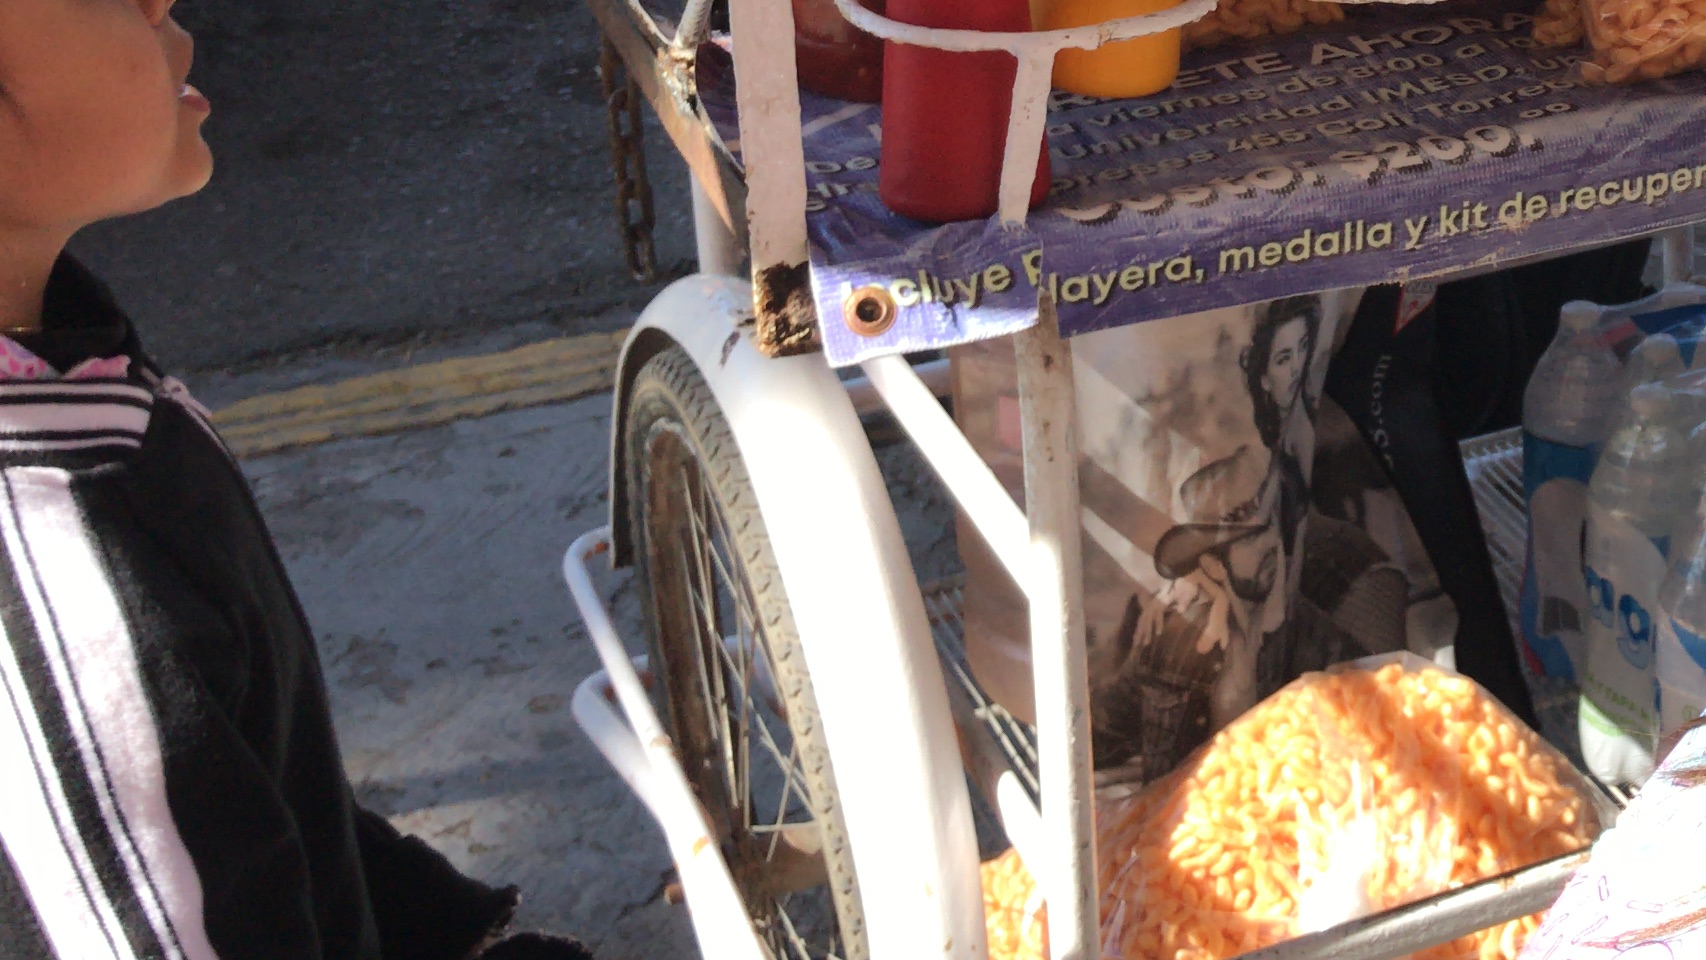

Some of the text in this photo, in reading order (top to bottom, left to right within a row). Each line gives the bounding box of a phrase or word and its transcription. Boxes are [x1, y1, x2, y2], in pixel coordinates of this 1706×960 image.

[1057, 94, 1352, 160] Universidad
[1087, 87, 1267, 129] viernes
[1277, 69, 1337, 95] de
[1349, 53, 1446, 80] 8:00
[1456, 41, 1487, 59] a
[840, 267, 1013, 308] cluye
[1219, 219, 1394, 275] medalla
[1404, 215, 1429, 251] y
[1438, 199, 1489, 236] kit
[1499, 191, 1548, 226] de
